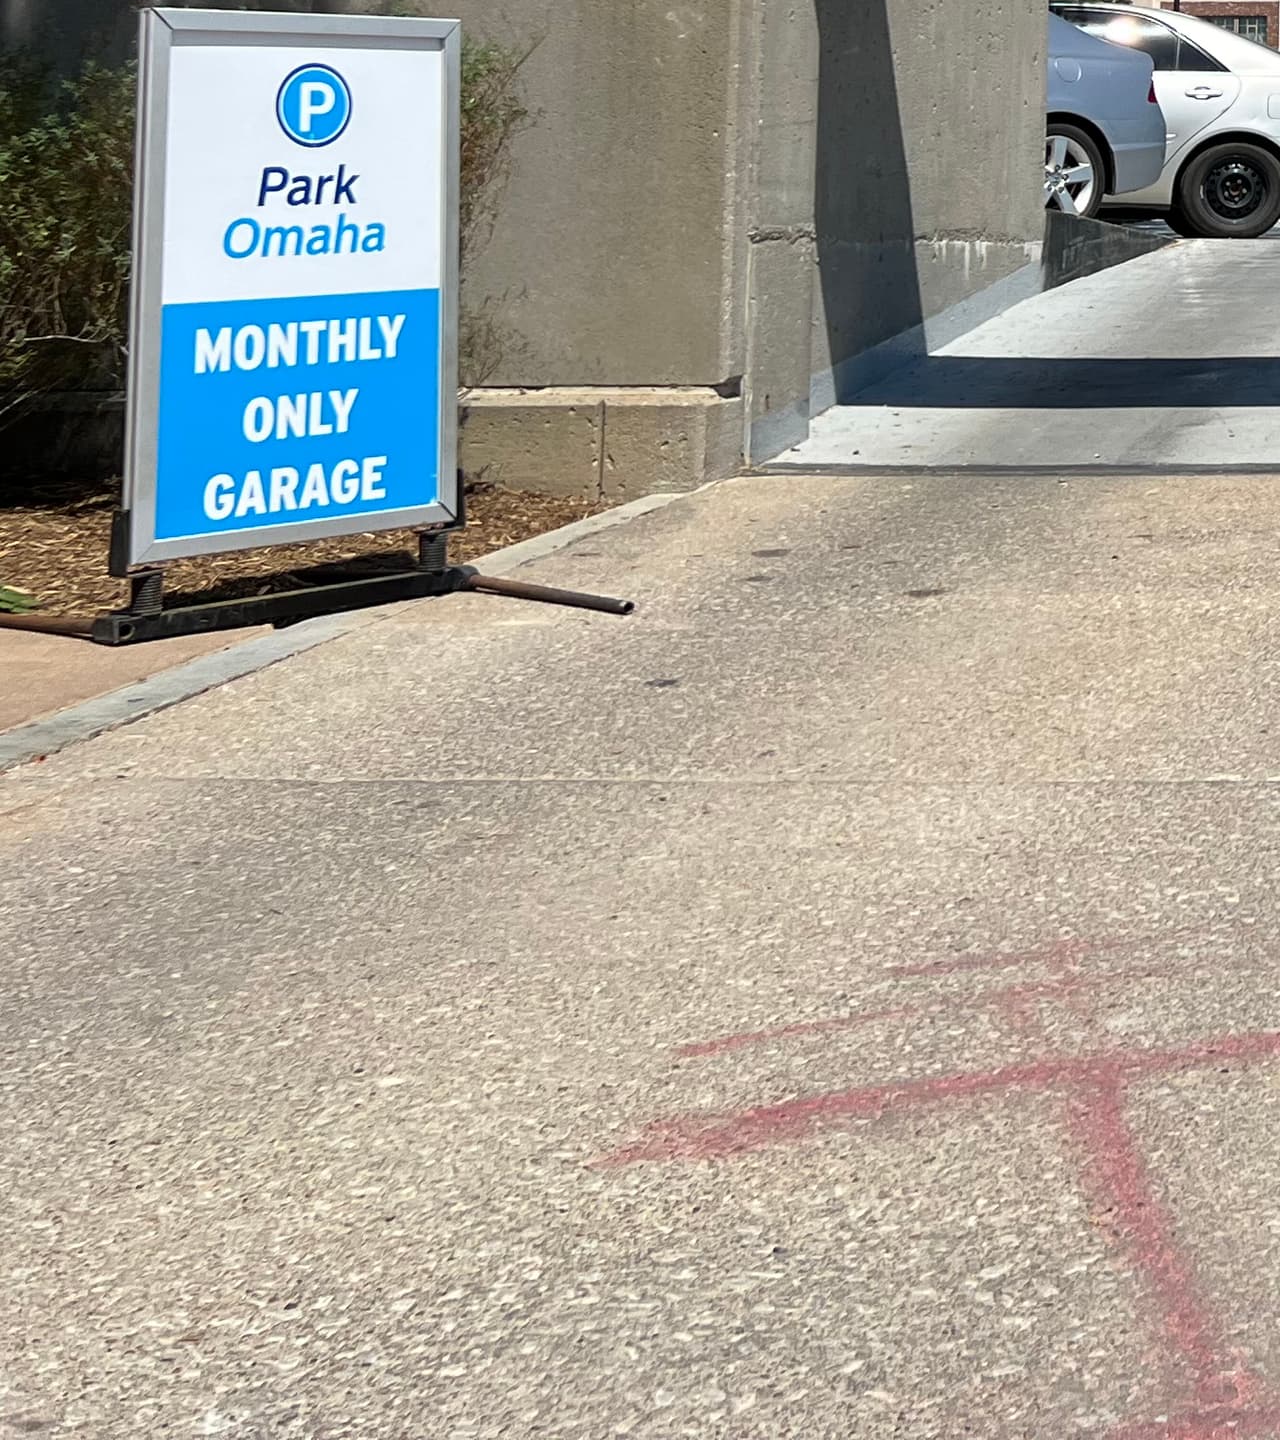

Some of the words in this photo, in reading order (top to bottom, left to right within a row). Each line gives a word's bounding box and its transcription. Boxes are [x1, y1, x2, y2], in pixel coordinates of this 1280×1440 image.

[299, 81, 336, 132] P
[257, 164, 360, 207] Park
[222, 213, 386, 259] Omaha
[194, 314, 406, 375] MONTHLY
[242, 388, 359, 443] ONLY
[203, 456, 387, 521] GARAGE
